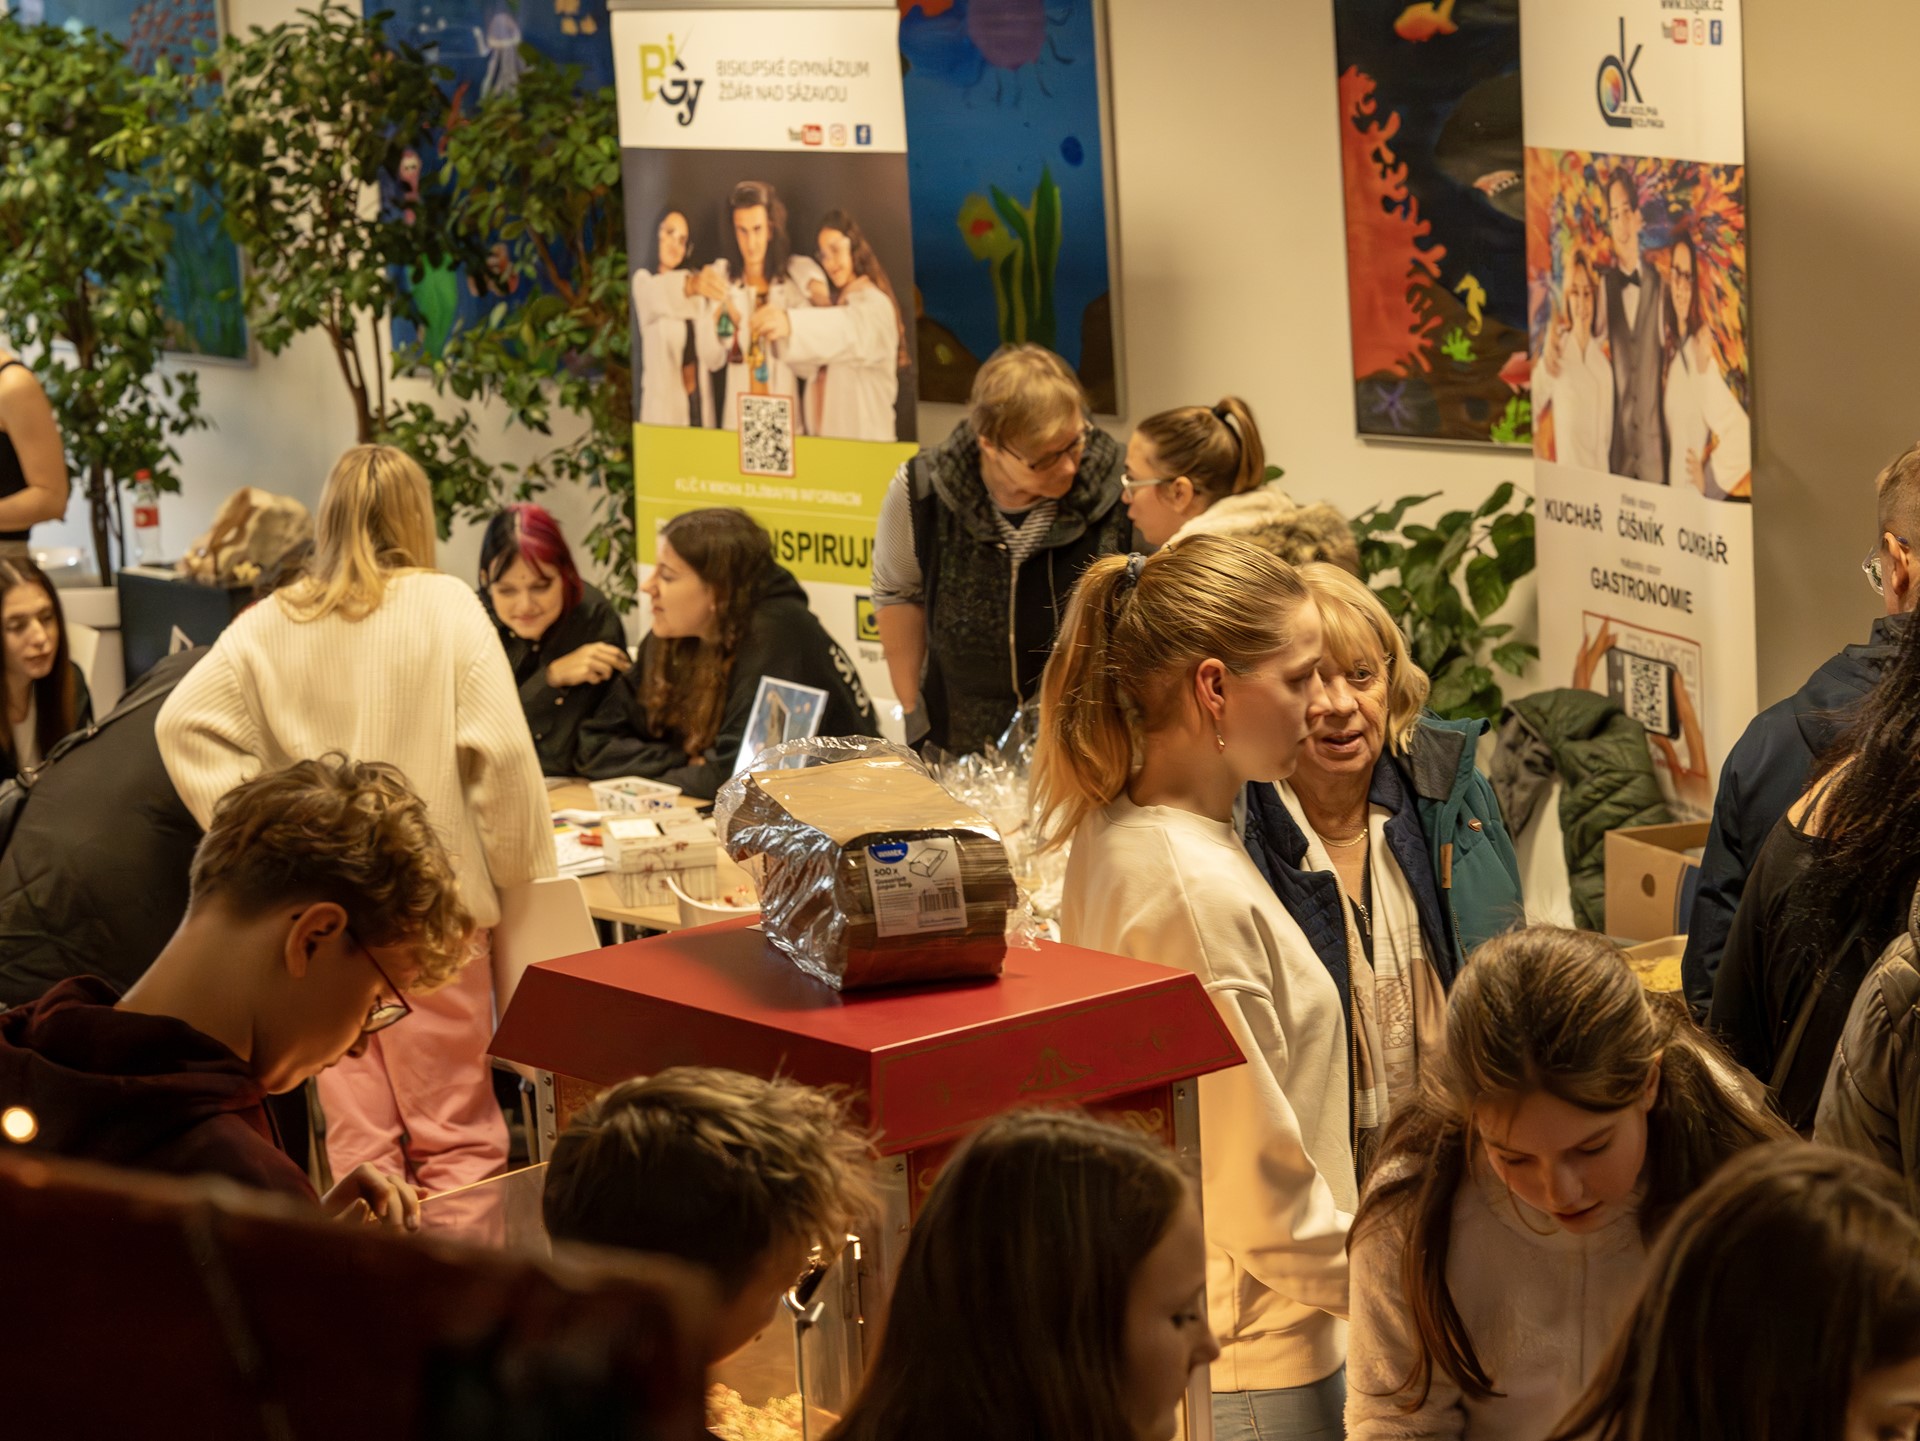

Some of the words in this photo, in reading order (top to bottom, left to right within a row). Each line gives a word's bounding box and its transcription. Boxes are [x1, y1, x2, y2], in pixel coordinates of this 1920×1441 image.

[716, 58, 785, 78] BISKUPSKÉ
[788, 57, 870, 78] GYMNÁZIUM
[756, 84, 784, 102] NAD
[787, 82, 848, 103] SÁZAVOU
[1544, 498, 1603, 532] KUCHAŘ
[1617, 509, 1665, 546] ČÍŠNÍK
[1677, 528, 1729, 564] CUKRÁŘ
[1590, 566, 1693, 614] GASTRONOMIE
[874, 867, 892, 877] 500
